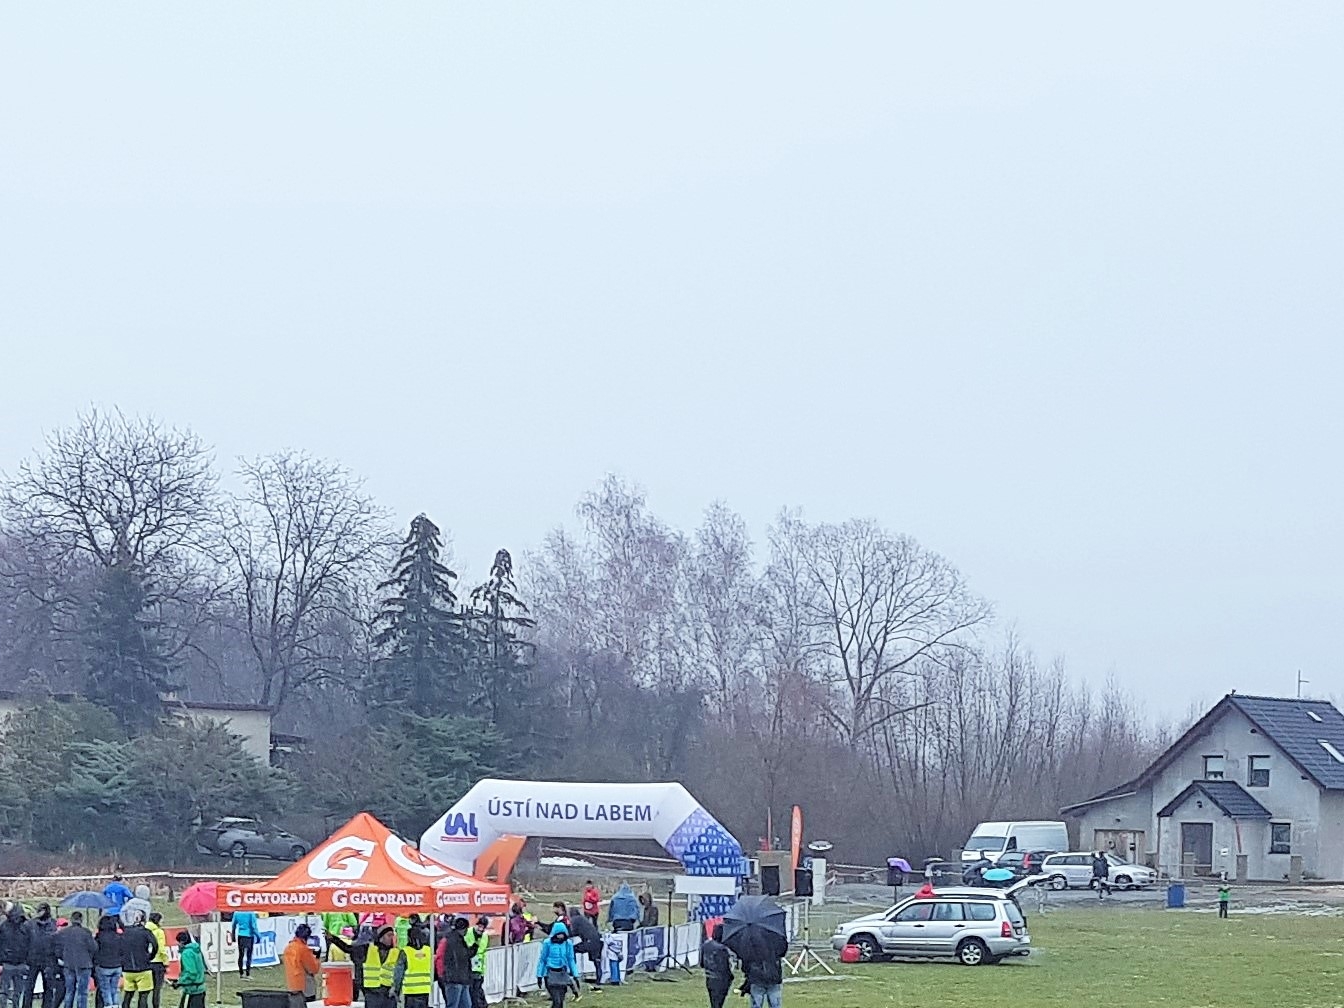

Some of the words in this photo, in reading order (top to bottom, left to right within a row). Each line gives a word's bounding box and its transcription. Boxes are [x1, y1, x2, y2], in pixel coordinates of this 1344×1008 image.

[488, 796, 532, 817] ÚSTÍ
[536, 802, 578, 819] NAD
[584, 804, 652, 821] LABEM
[243, 893, 316, 905] GATORADE
[350, 892, 424, 906] GATORADE
